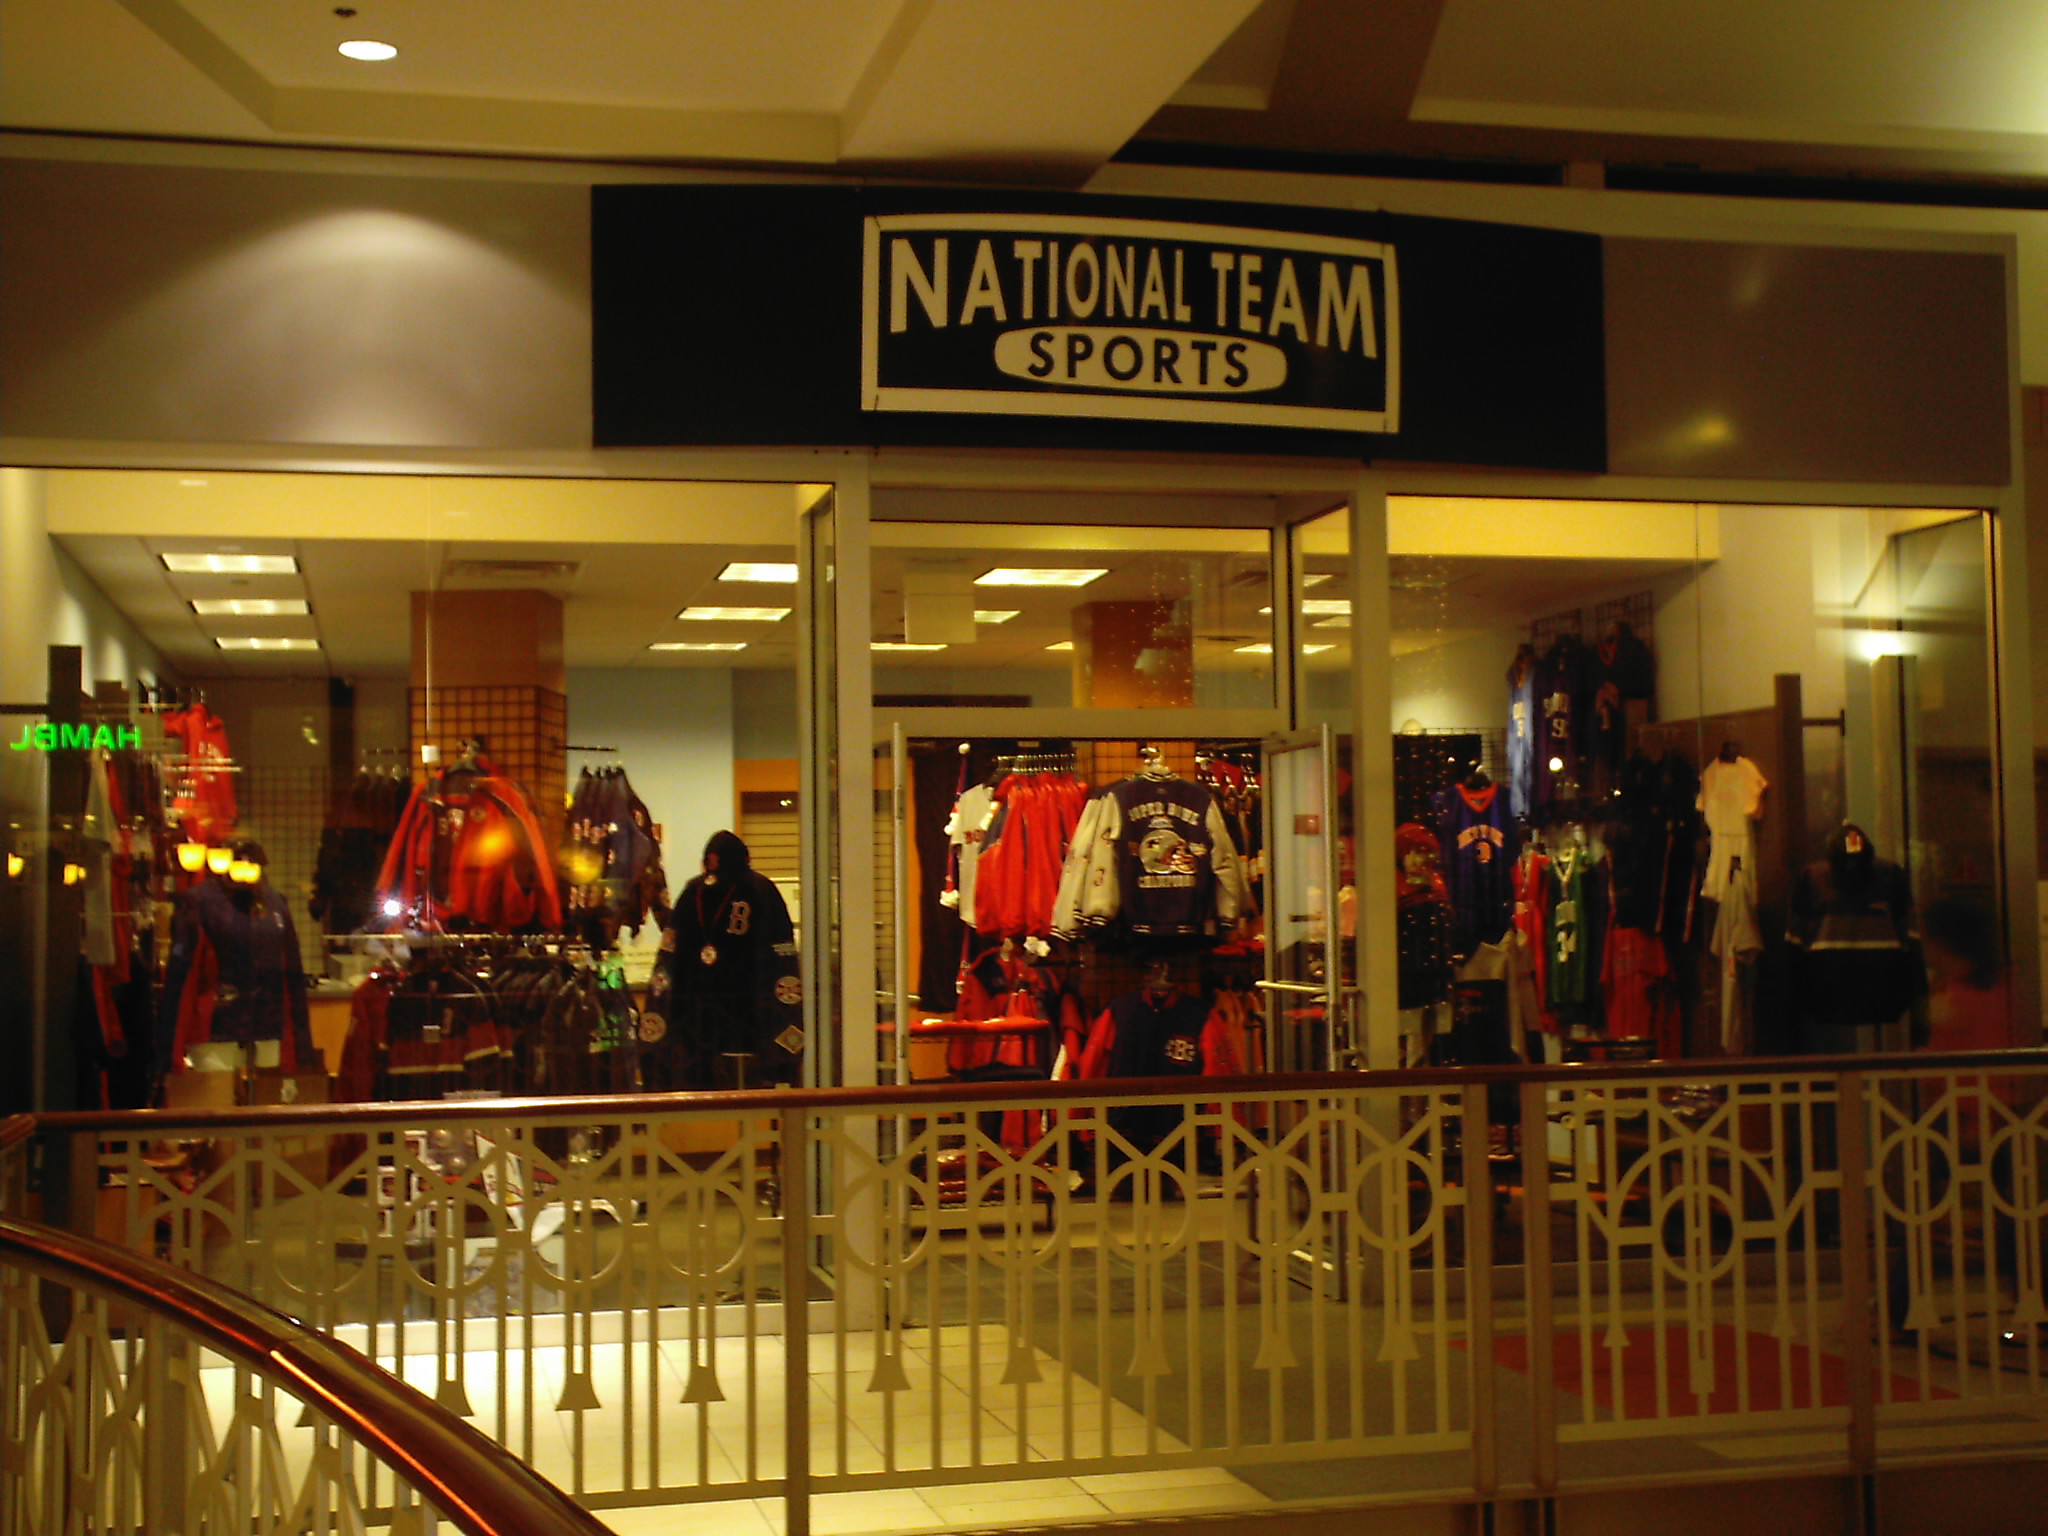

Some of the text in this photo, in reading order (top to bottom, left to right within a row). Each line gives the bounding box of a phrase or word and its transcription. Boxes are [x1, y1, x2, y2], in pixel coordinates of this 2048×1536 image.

[890, 238, 1378, 359] NATIONAL TEAM
[1026, 331, 1250, 388] SPORTS
